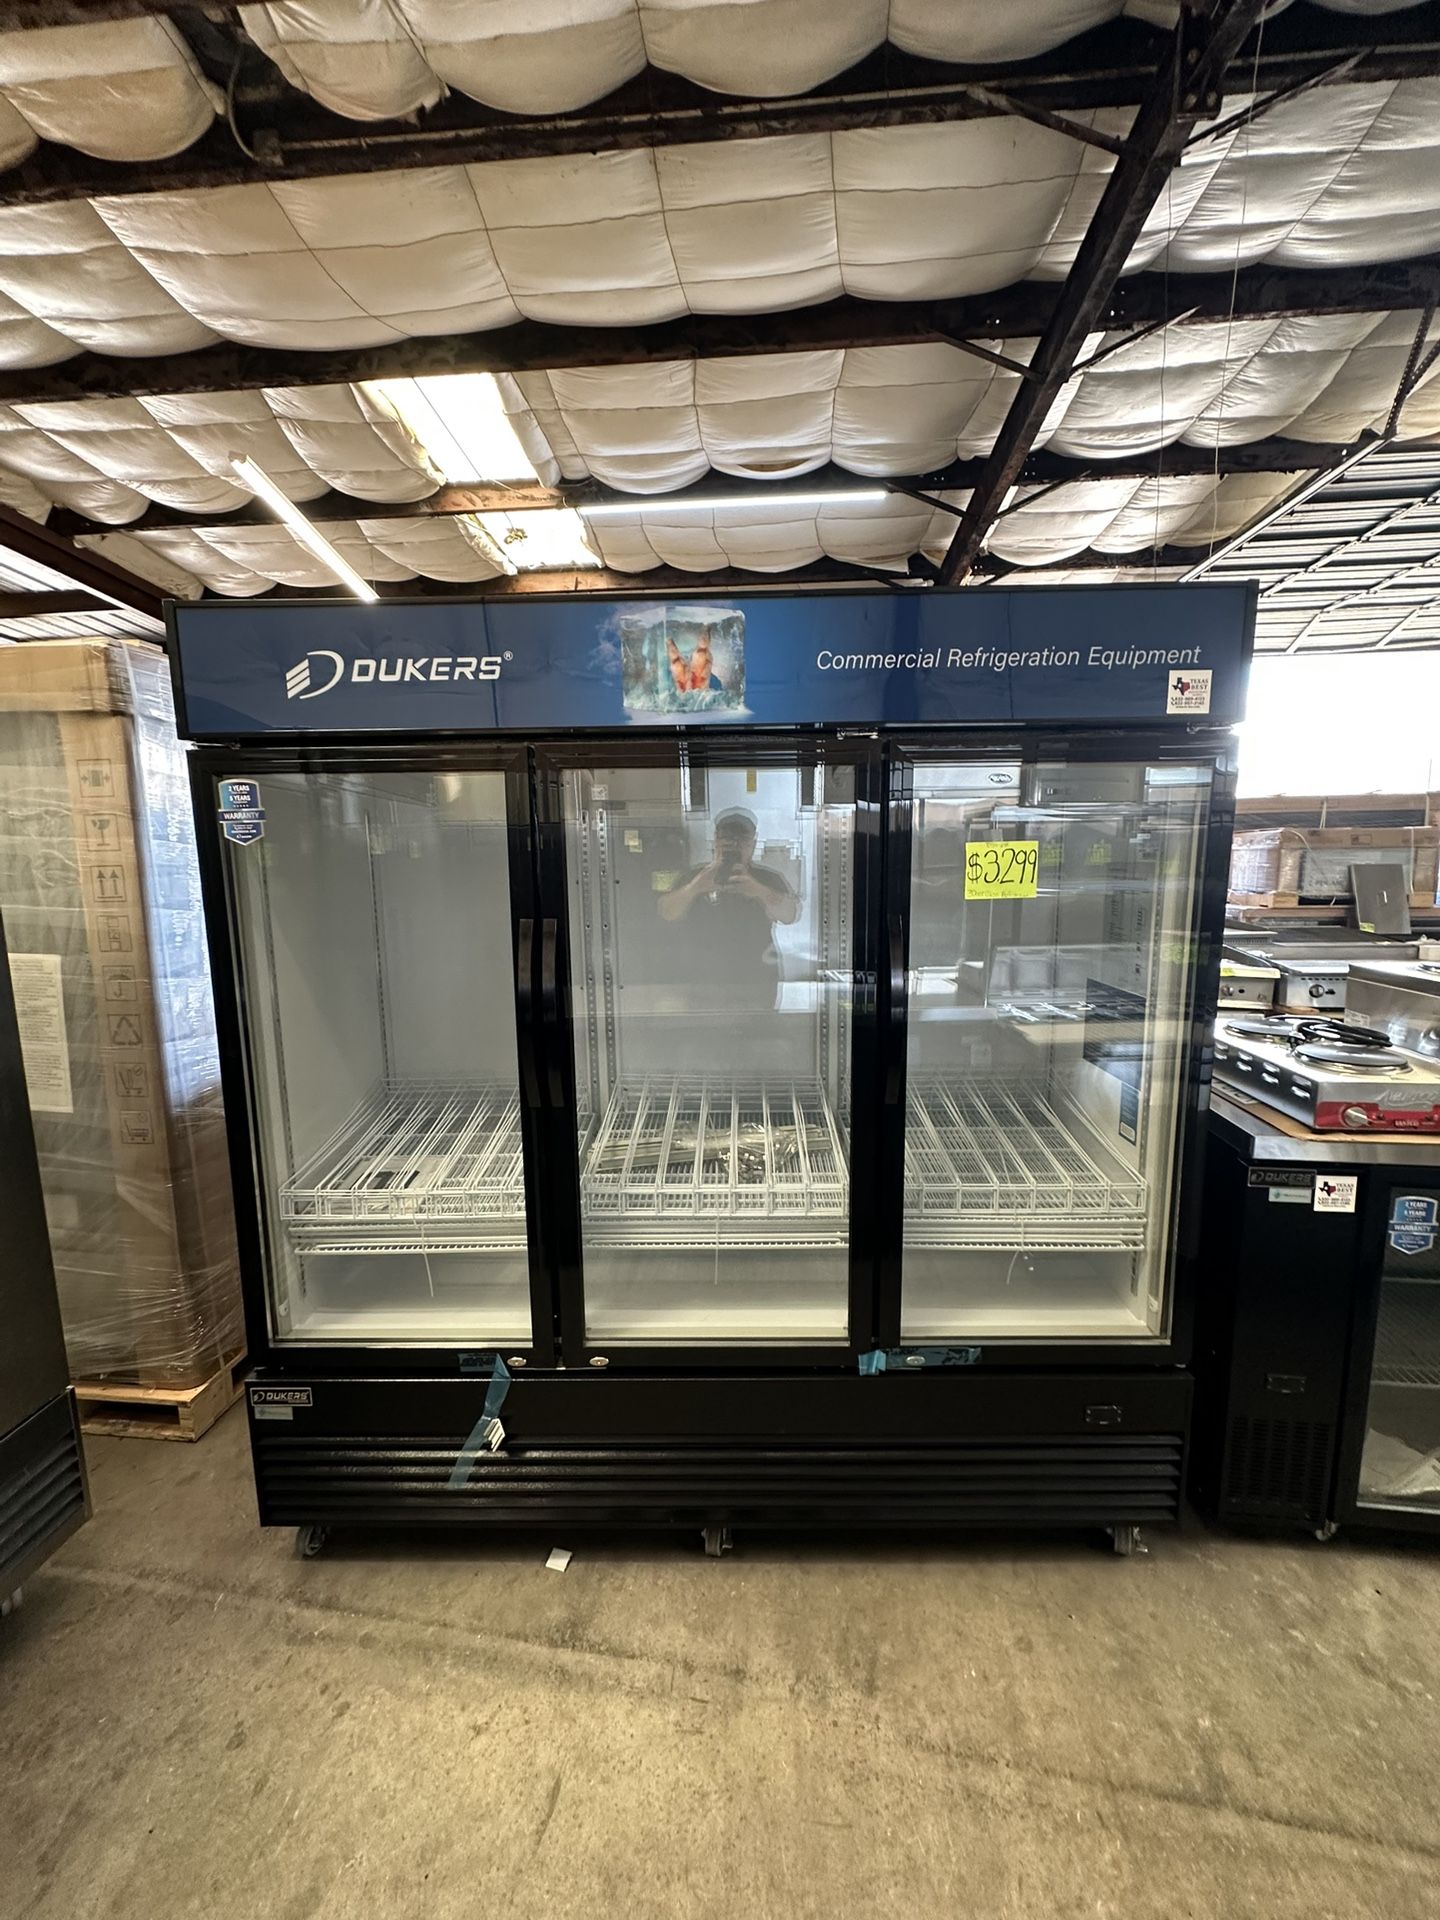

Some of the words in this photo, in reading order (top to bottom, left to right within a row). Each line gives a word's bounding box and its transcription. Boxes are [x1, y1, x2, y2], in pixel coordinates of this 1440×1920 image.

[816, 647, 942, 670] Commercial
[946, 646, 1080, 671] Refrigeration
[1087, 645, 1202, 670] Equipment
[1393, 1224, 1432, 1232] WARRANTY
[266, 1391, 308, 1400] DUKERS
